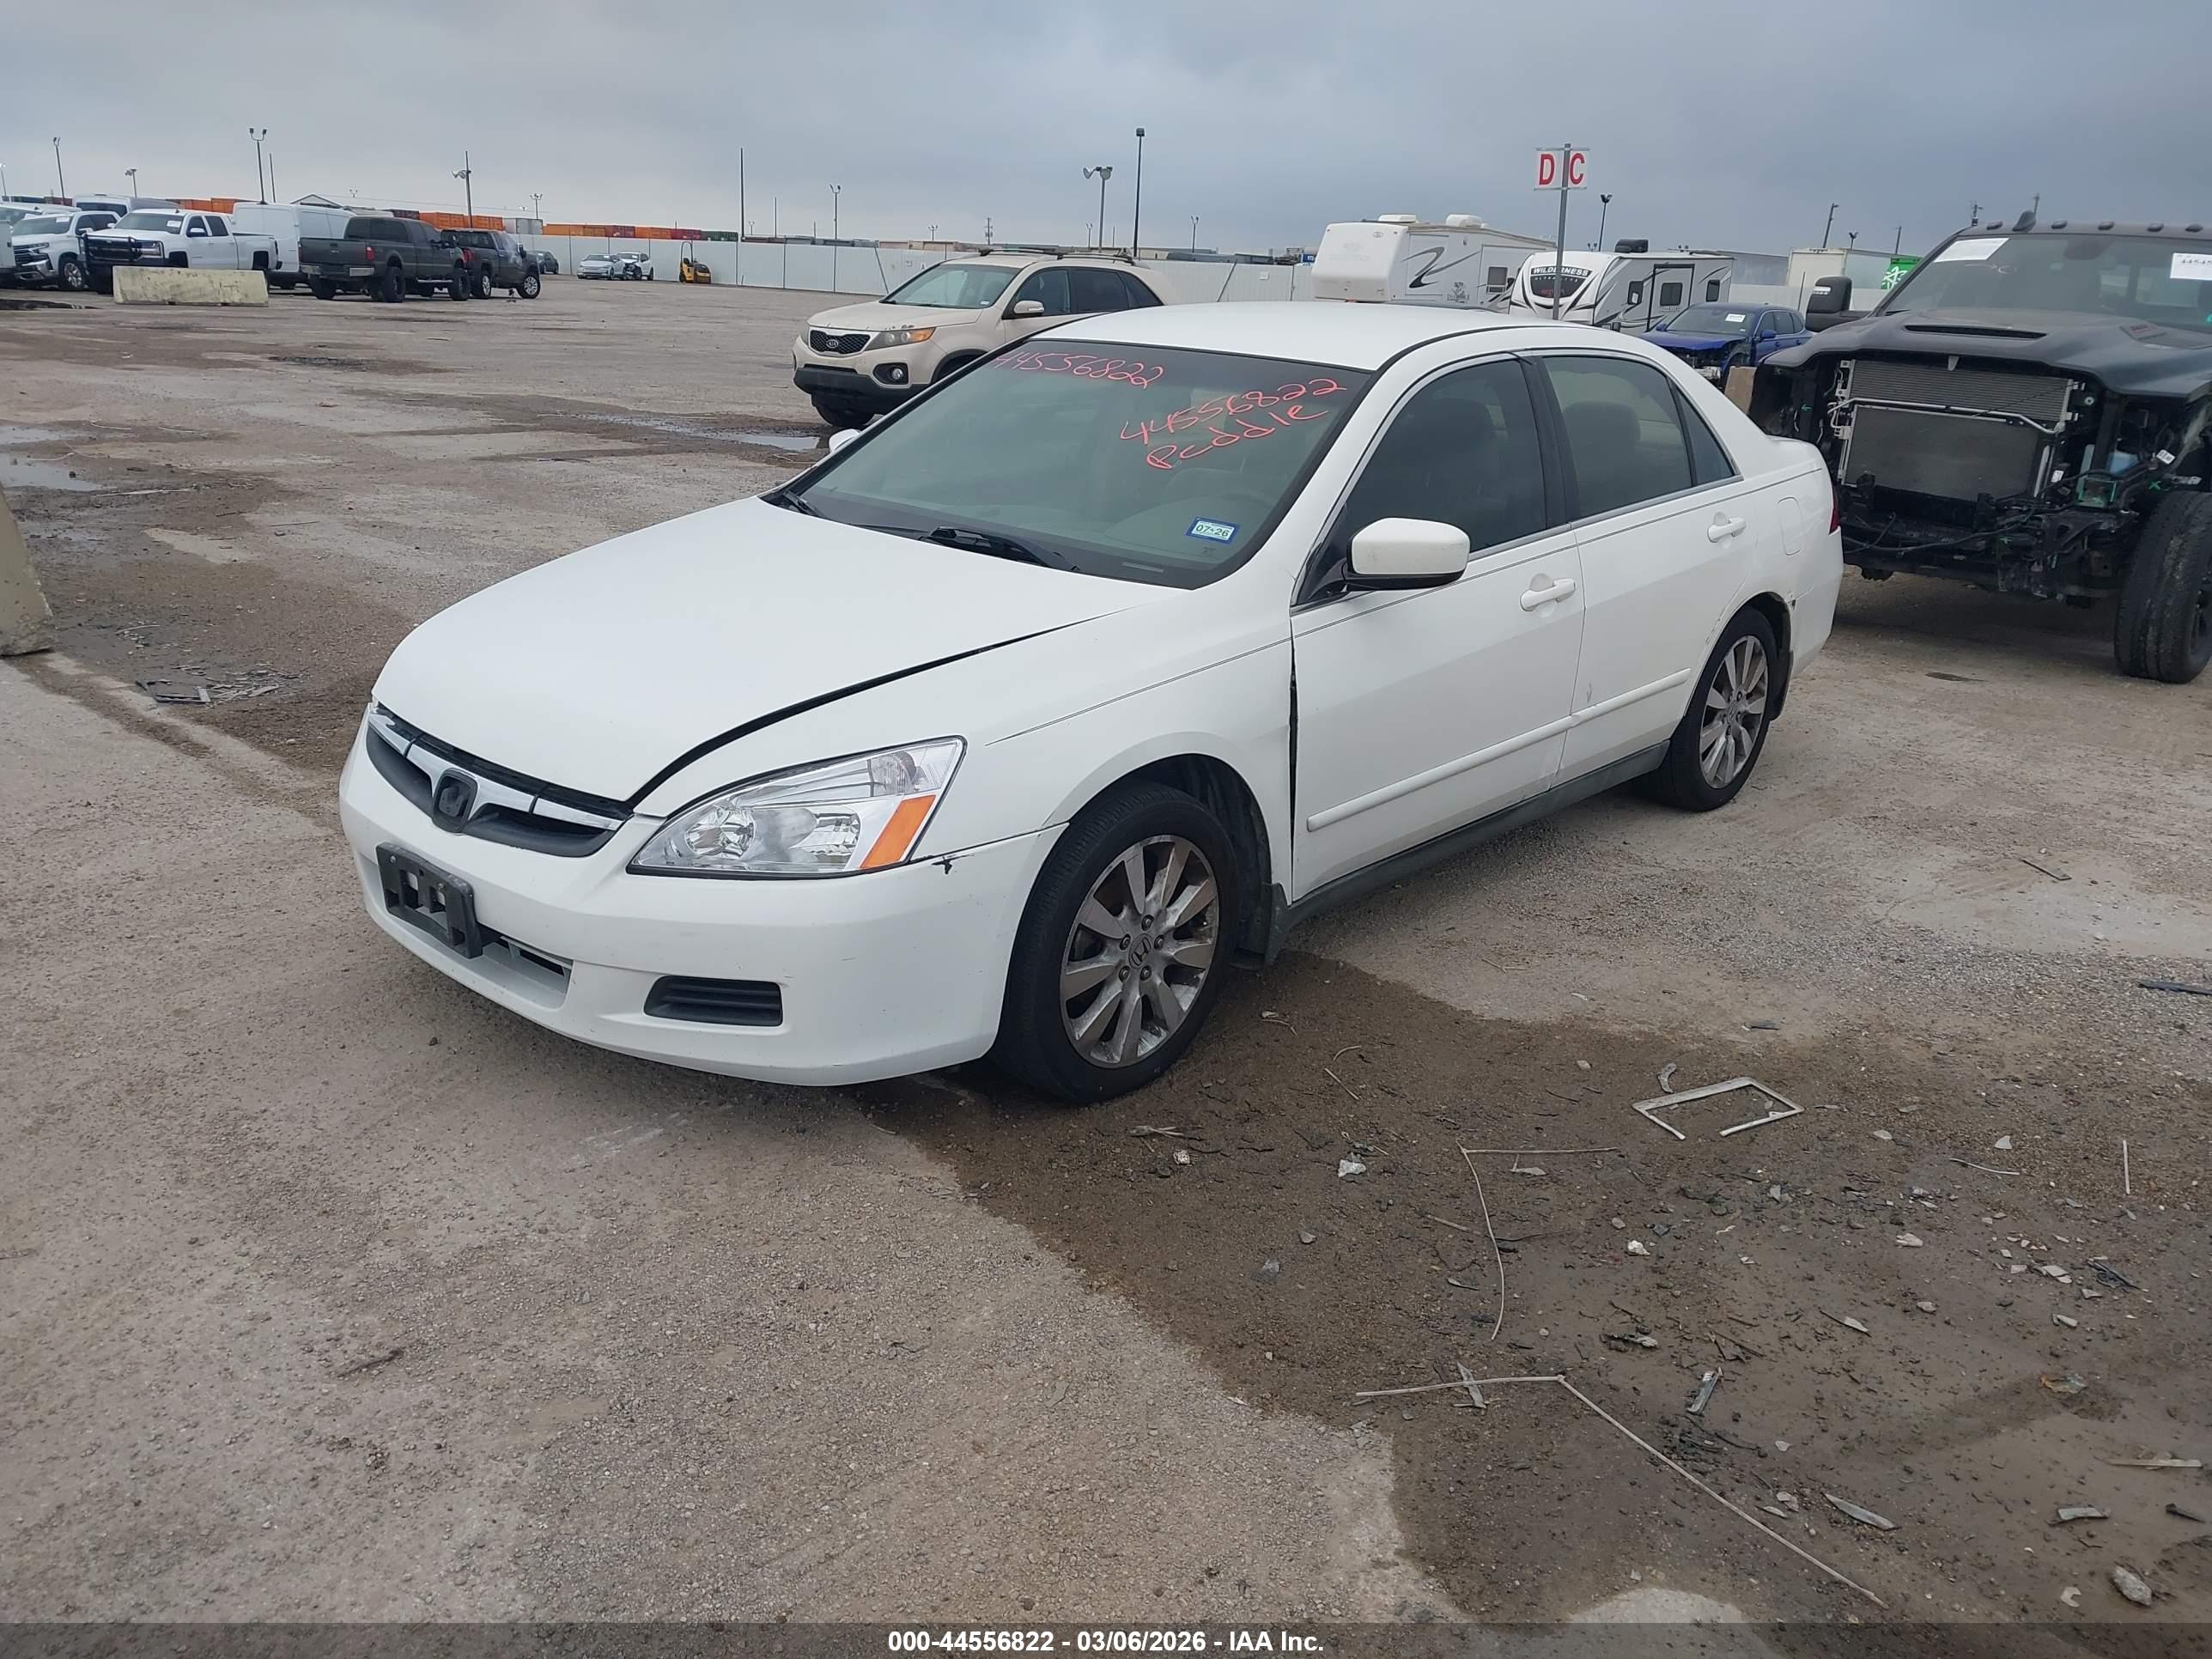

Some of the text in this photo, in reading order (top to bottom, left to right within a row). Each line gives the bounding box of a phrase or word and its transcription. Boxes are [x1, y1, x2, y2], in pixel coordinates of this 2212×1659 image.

[1539, 154, 1555, 185] D
[1570, 153, 1585, 185] C
[994, 352, 1164, 390] 44556822
[1120, 378, 1347, 446] 44556822
